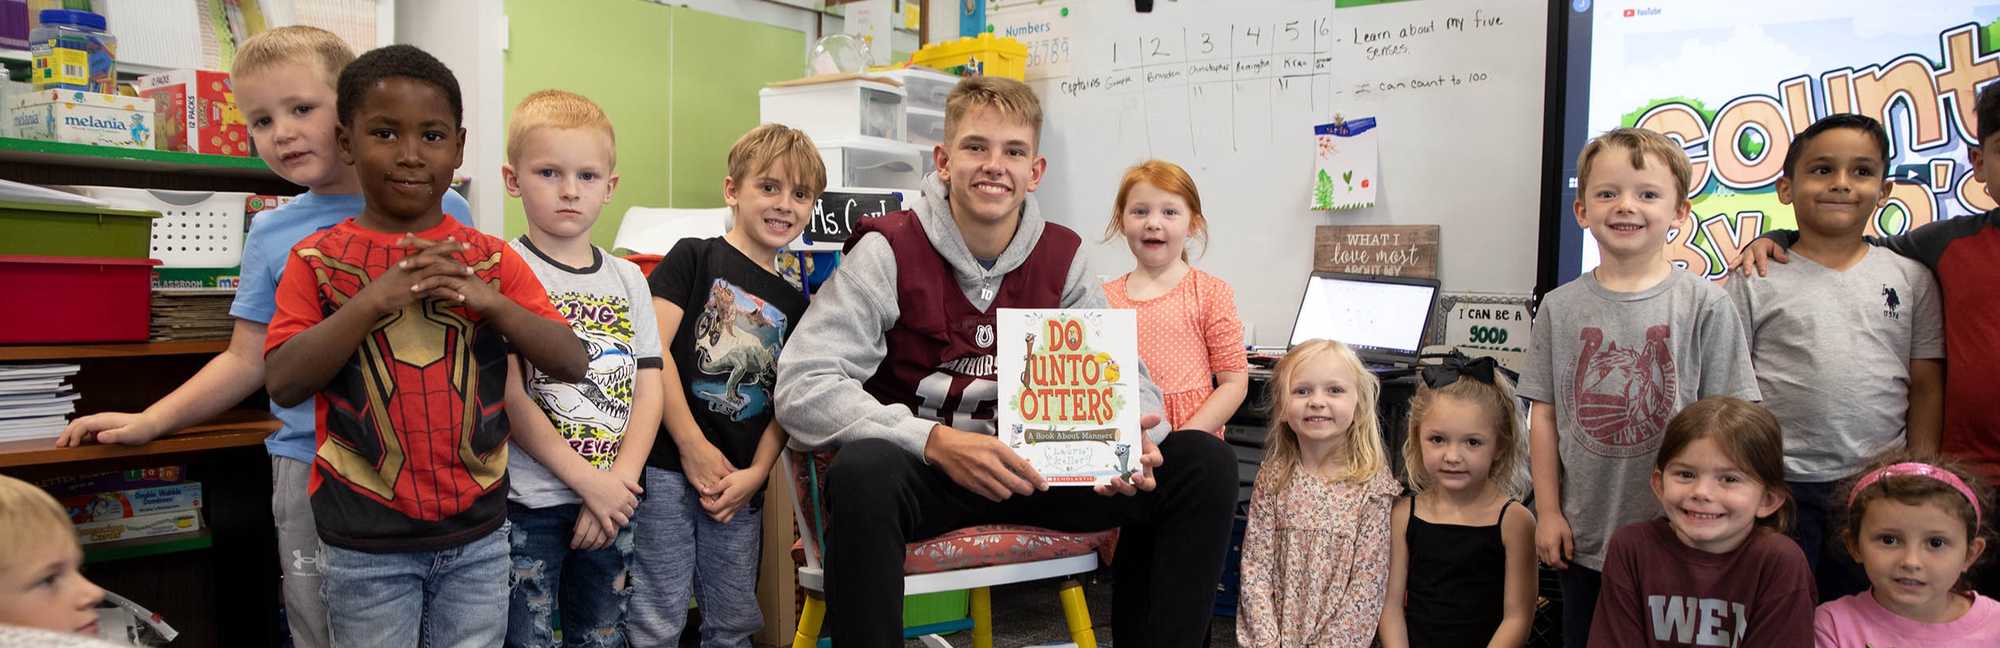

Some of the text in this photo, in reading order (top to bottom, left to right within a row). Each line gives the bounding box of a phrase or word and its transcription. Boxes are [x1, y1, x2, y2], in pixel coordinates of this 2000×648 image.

[1006, 22, 1050, 37] Numbers
[1354, 9, 1503, 45] Learn about my five
[1151, 37, 1170, 57] 2
[1201, 33, 1214, 54] 3
[1246, 27, 1261, 48] 4
[1285, 20, 1300, 41] 5
[1320, 17, 1329, 36] 6
[1380, 82, 1406, 91] can
[1411, 75, 1445, 89] count
[1452, 74, 1461, 85] to
[1469, 73, 1487, 83] 100
[65, 115, 127, 130] melania
[811, 198, 841, 235] Ms.
[1347, 234, 1400, 246] WHAT I
[1331, 241, 1419, 266] love most
[1383, 265, 1402, 276] MY
[981, 289, 993, 300] 10
[1468, 309, 1490, 320] CAN
[1515, 311, 1522, 320] A
[1048, 320, 1083, 352] DO
[1030, 354, 1100, 386] UNTO
[1020, 386, 1114, 425] OTTERS
[1057, 432, 1080, 440] About
[1082, 432, 1113, 440] Manners
